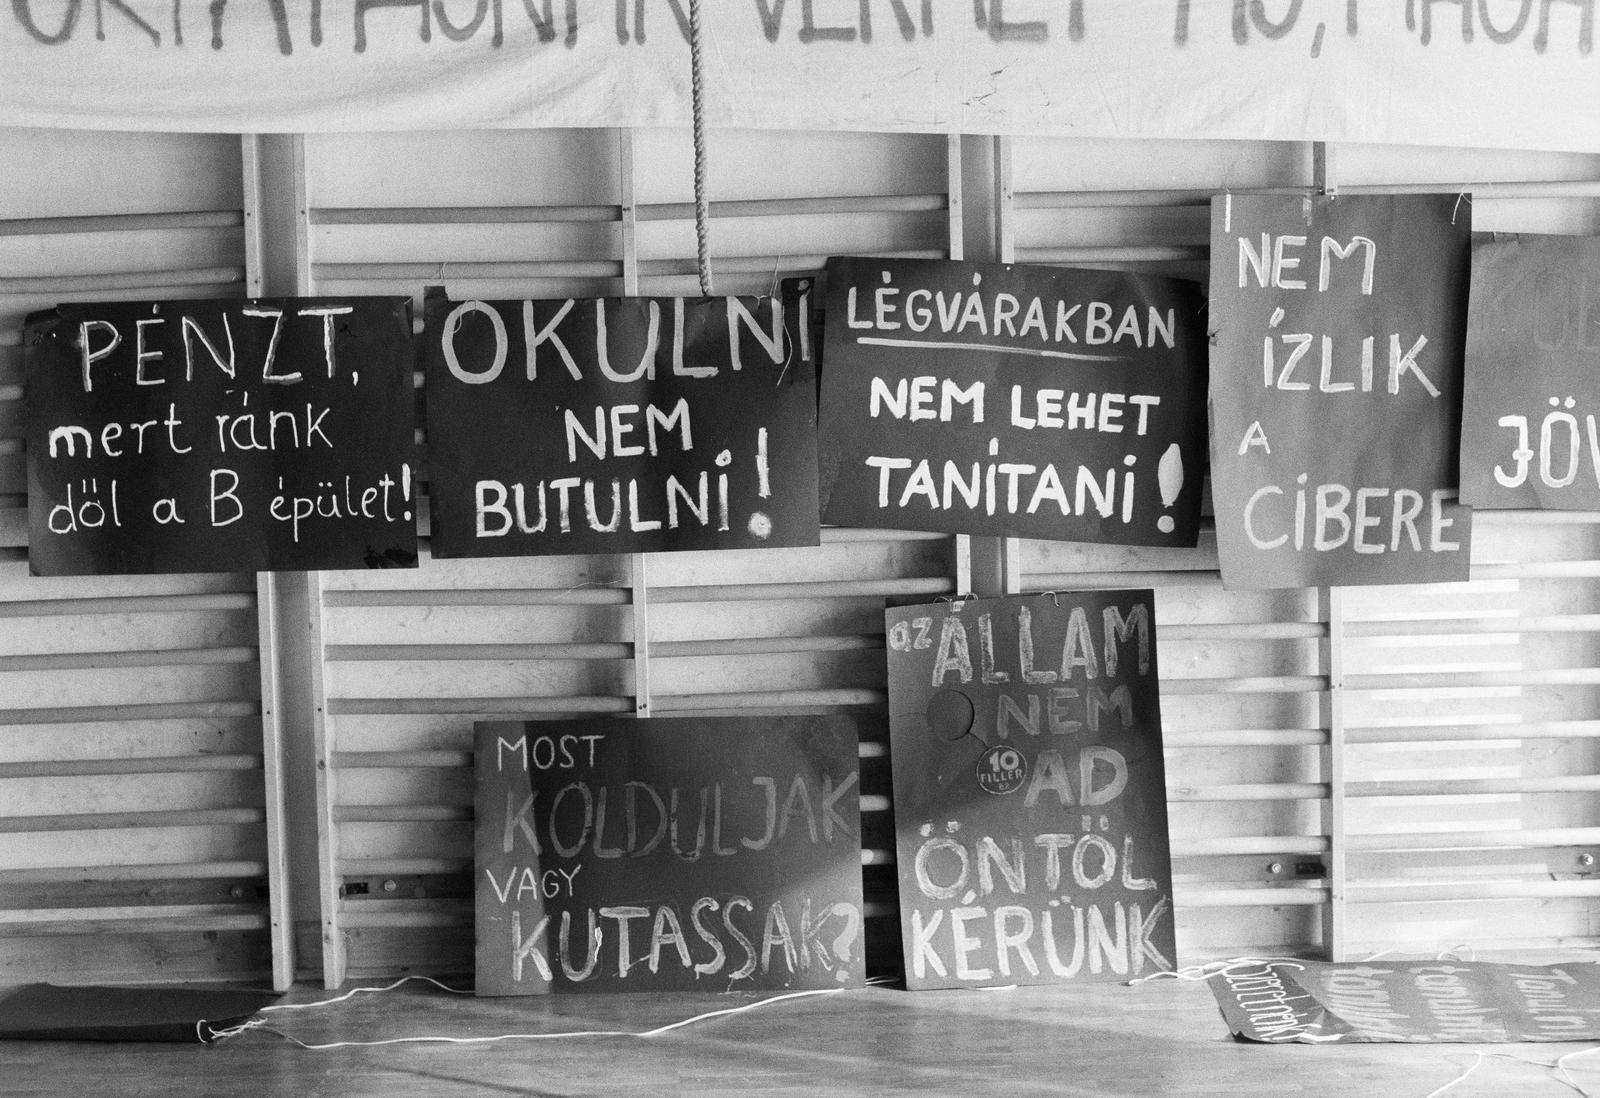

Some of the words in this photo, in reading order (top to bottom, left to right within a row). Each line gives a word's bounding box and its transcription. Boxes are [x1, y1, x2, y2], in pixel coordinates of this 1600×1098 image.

[1238, 231, 1376, 295] NEM
[1264, 307, 1442, 398] ÍZLIK
[49, 403, 192, 458] mert
[216, 391, 333, 453] ránk
[564, 397, 694, 463] NEM
[870, 376, 985, 424] NEM
[1011, 384, 1160, 436] LEHET
[1238, 421, 1271, 455] A
[153, 498, 185, 524] a
[210, 469, 243, 526] B
[270, 463, 412, 542] épület!
[997, 684, 1134, 740] NEM
[497, 734, 605, 771] MOST
[989, 750, 1020, 773] 10
[1024, 745, 1128, 808] AD
[503, 771, 858, 862] KOLDULJAK
[486, 864, 581, 903] VAGY
[512, 896, 860, 983] KUTASSAK?
